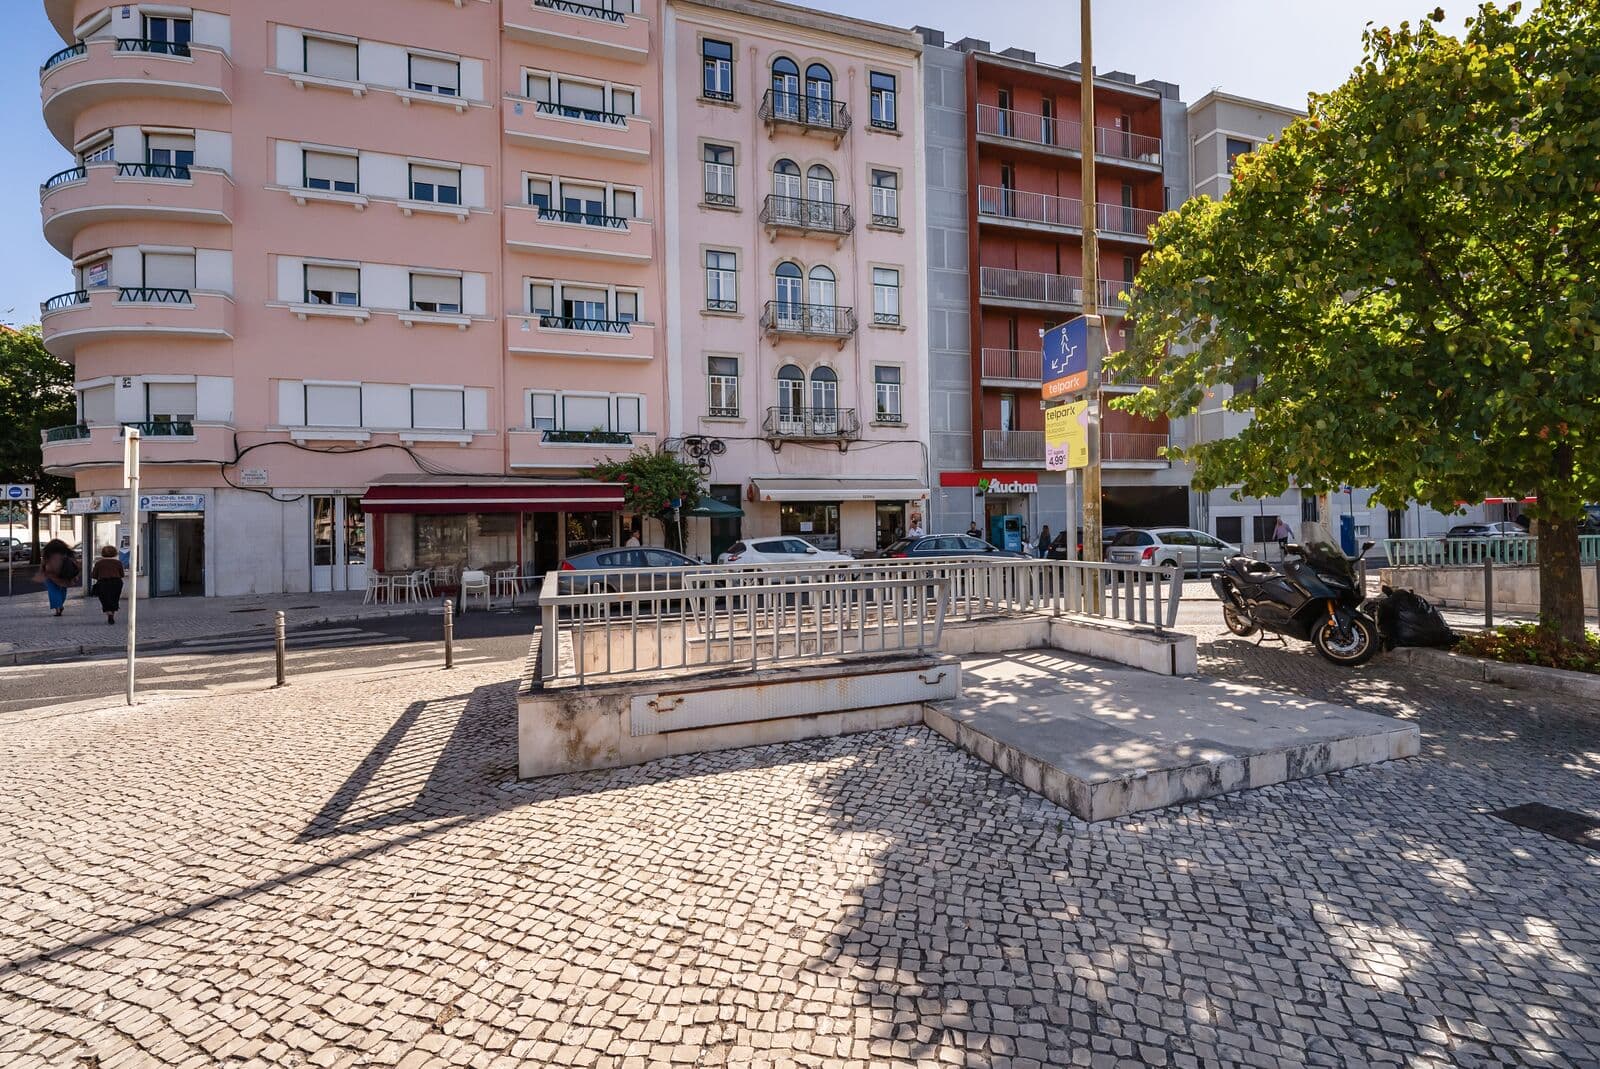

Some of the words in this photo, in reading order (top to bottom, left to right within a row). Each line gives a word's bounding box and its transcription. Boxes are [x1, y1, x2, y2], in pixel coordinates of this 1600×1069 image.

[1049, 376, 1080, 394] telpark
[1046, 406, 1075, 421] telpark
[988, 478, 1037, 493] Auchan
